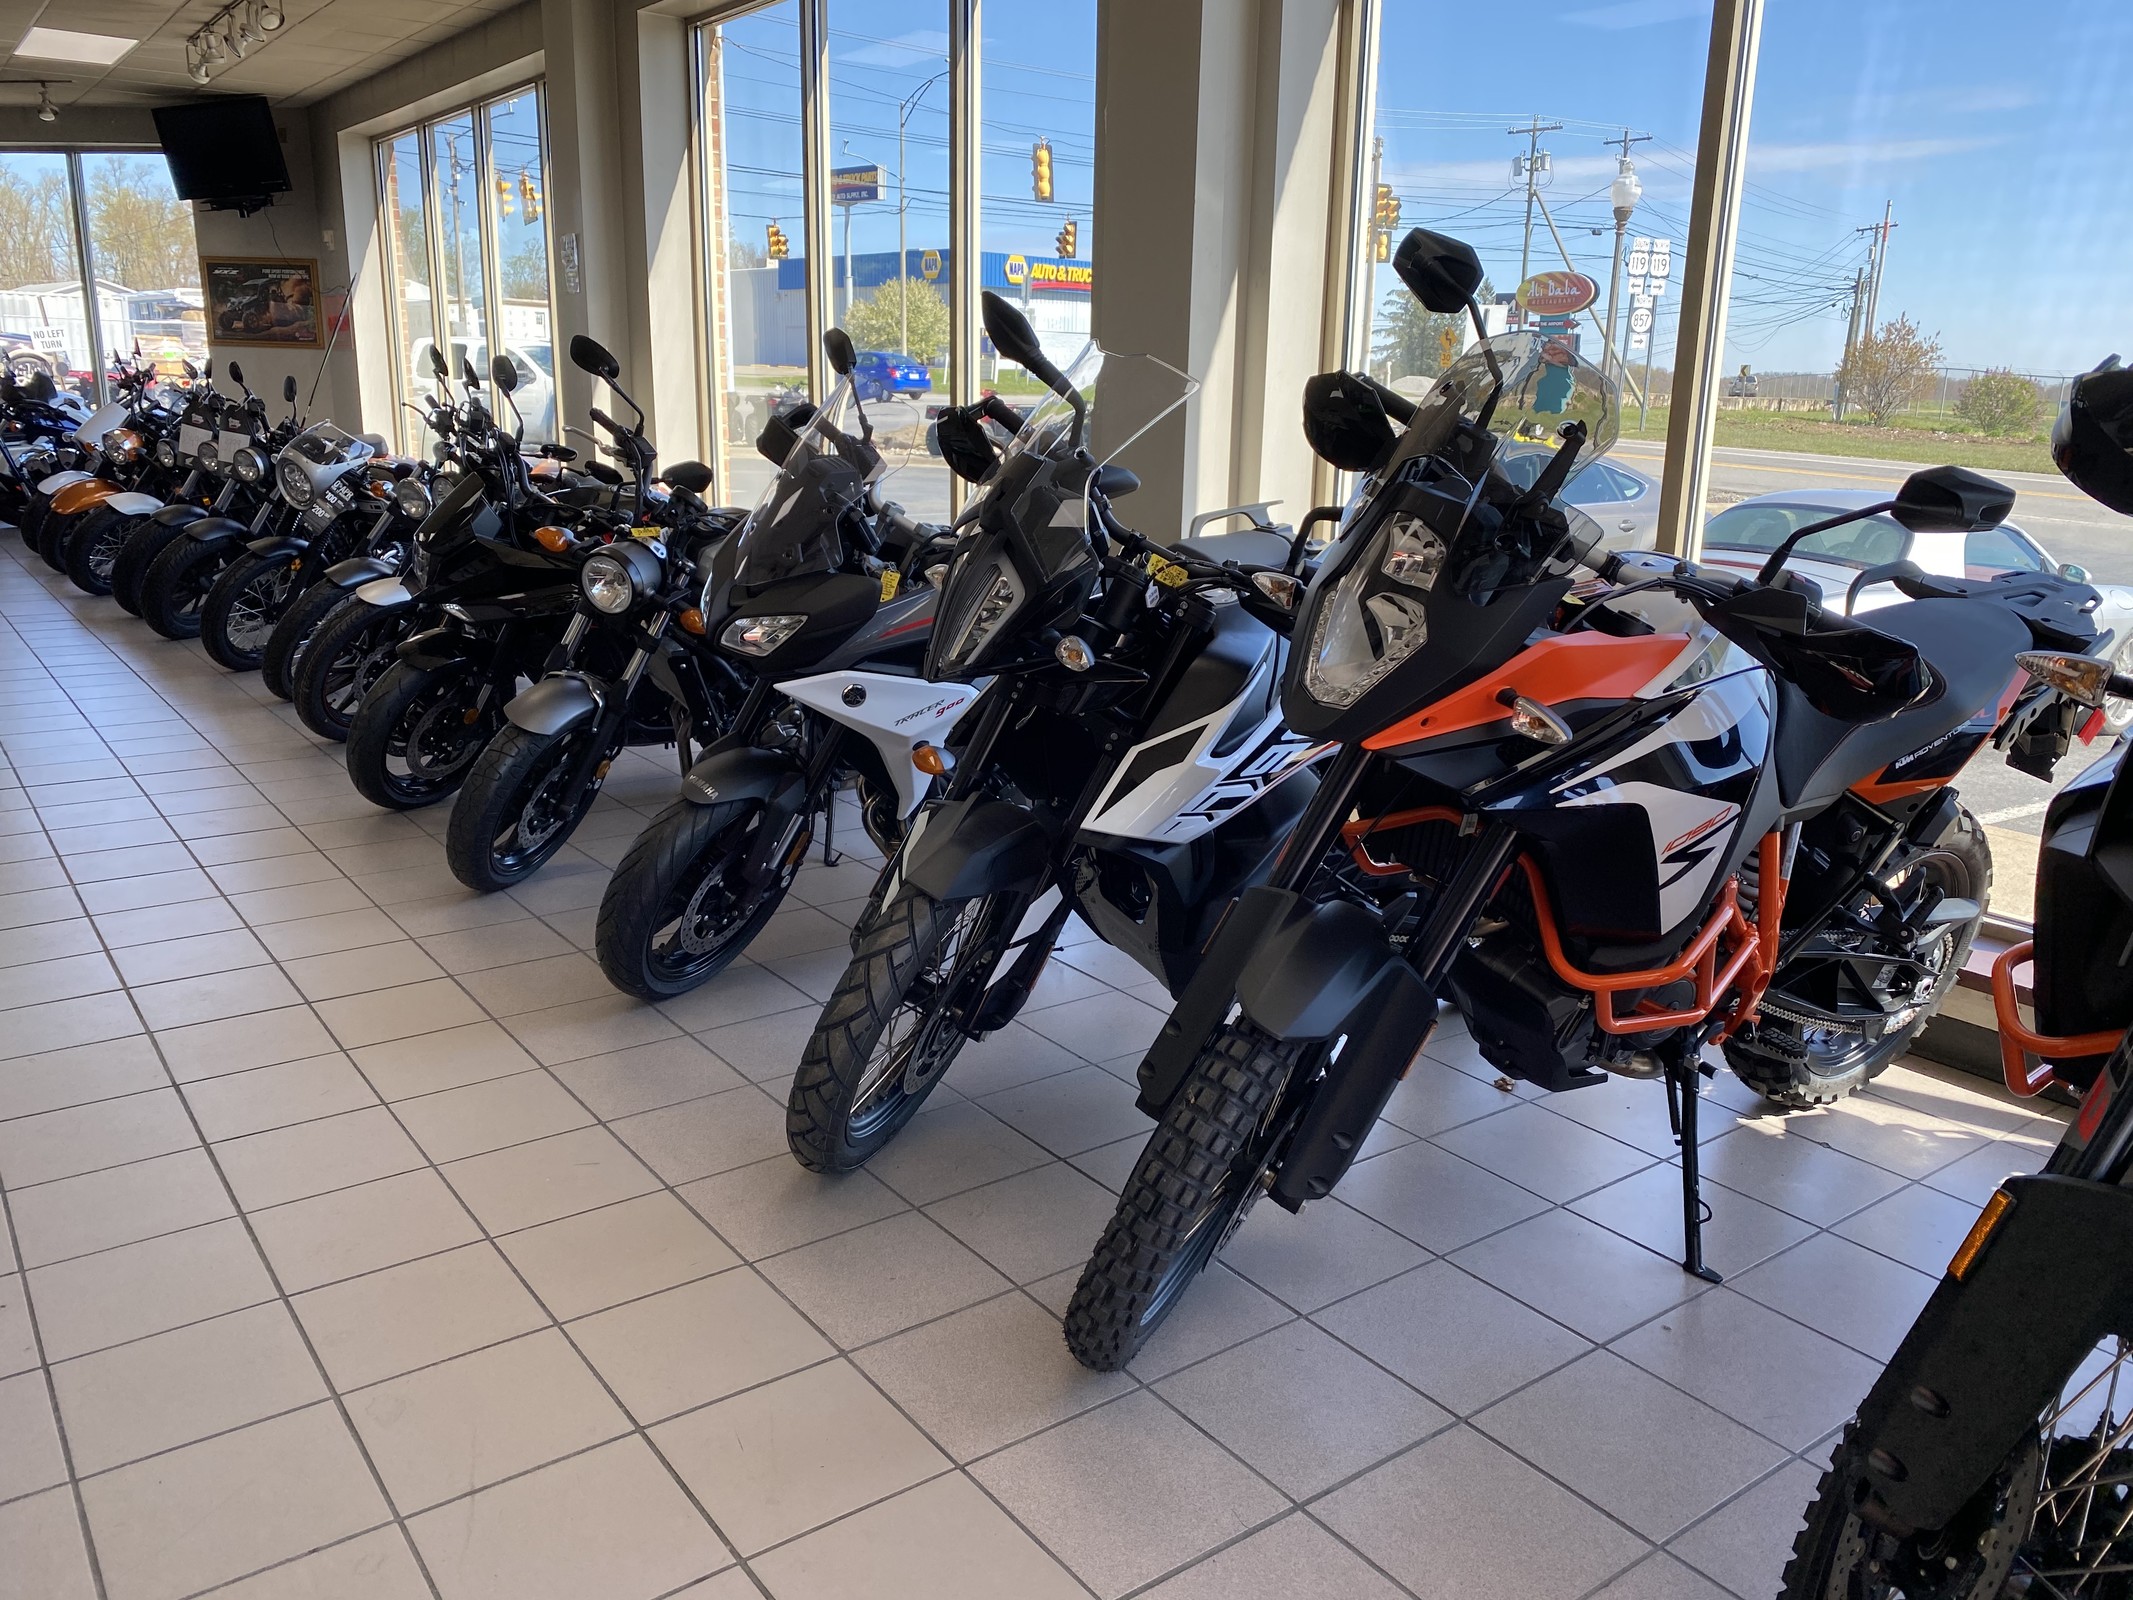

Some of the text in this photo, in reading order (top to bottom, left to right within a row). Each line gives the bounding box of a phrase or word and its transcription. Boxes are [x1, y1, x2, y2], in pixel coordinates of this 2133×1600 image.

[924, 258, 938, 271] NAPA
[1009, 263, 1025, 276] NAPA
[1631, 256, 1647, 271] 119
[1653, 258, 1668, 272] 119
[1031, 263, 1056, 279] AUTO
[1057, 266, 1067, 281] &
[1527, 279, 1580, 297] Ali Baba
[1633, 314, 1650, 327] 857
[33, 329, 65, 339] NO LEFT
[40, 339, 63, 349] TURN
[893, 699, 945, 727] TRACER
[935, 697, 965, 718] 900
[1895, 754, 1915, 769] KTM
[689, 774, 719, 800] YAMAHA
[1660, 805, 1733, 856] 1090
